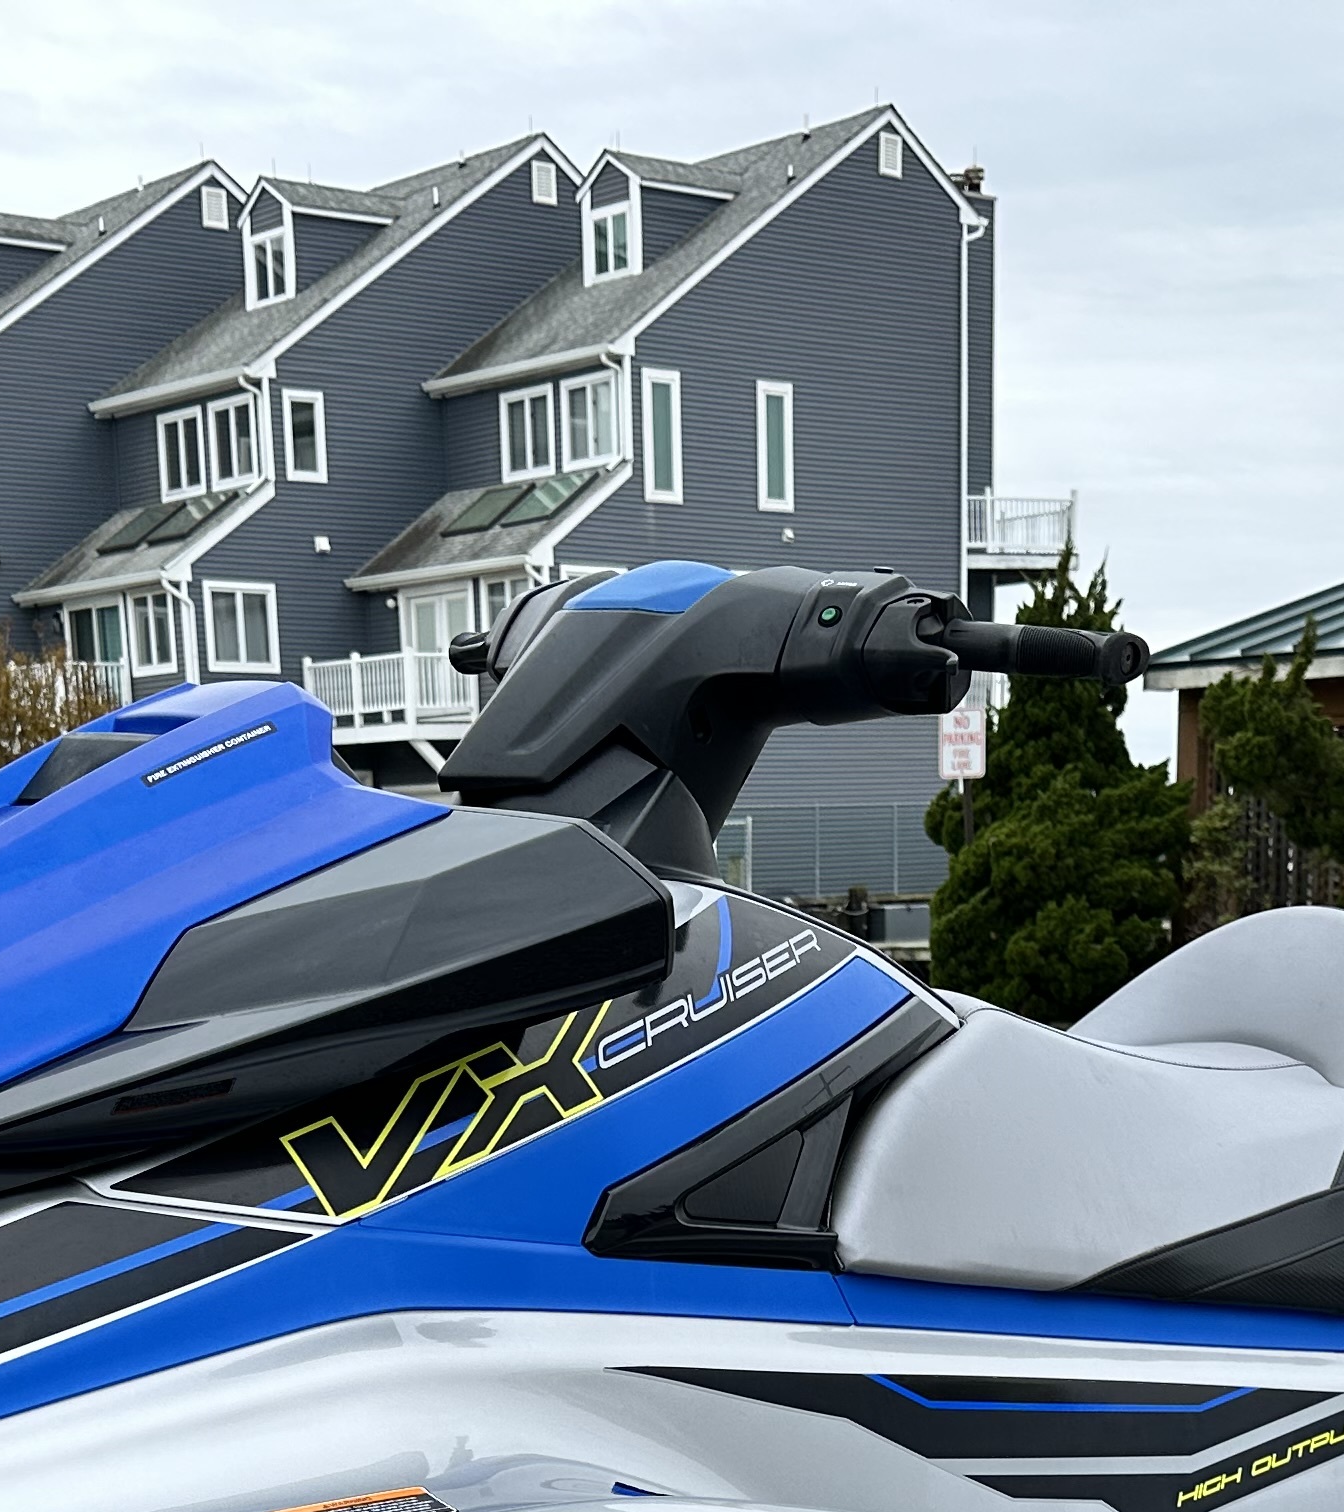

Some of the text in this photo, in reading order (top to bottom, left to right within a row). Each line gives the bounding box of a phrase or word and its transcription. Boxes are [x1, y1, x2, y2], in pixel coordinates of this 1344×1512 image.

[147, 770, 168, 782] FIRE
[225, 725, 271, 748] CONTAINER
[279, 928, 822, 1219] VX CRUISER
[1177, 1467, 1242, 1508] HIGH
